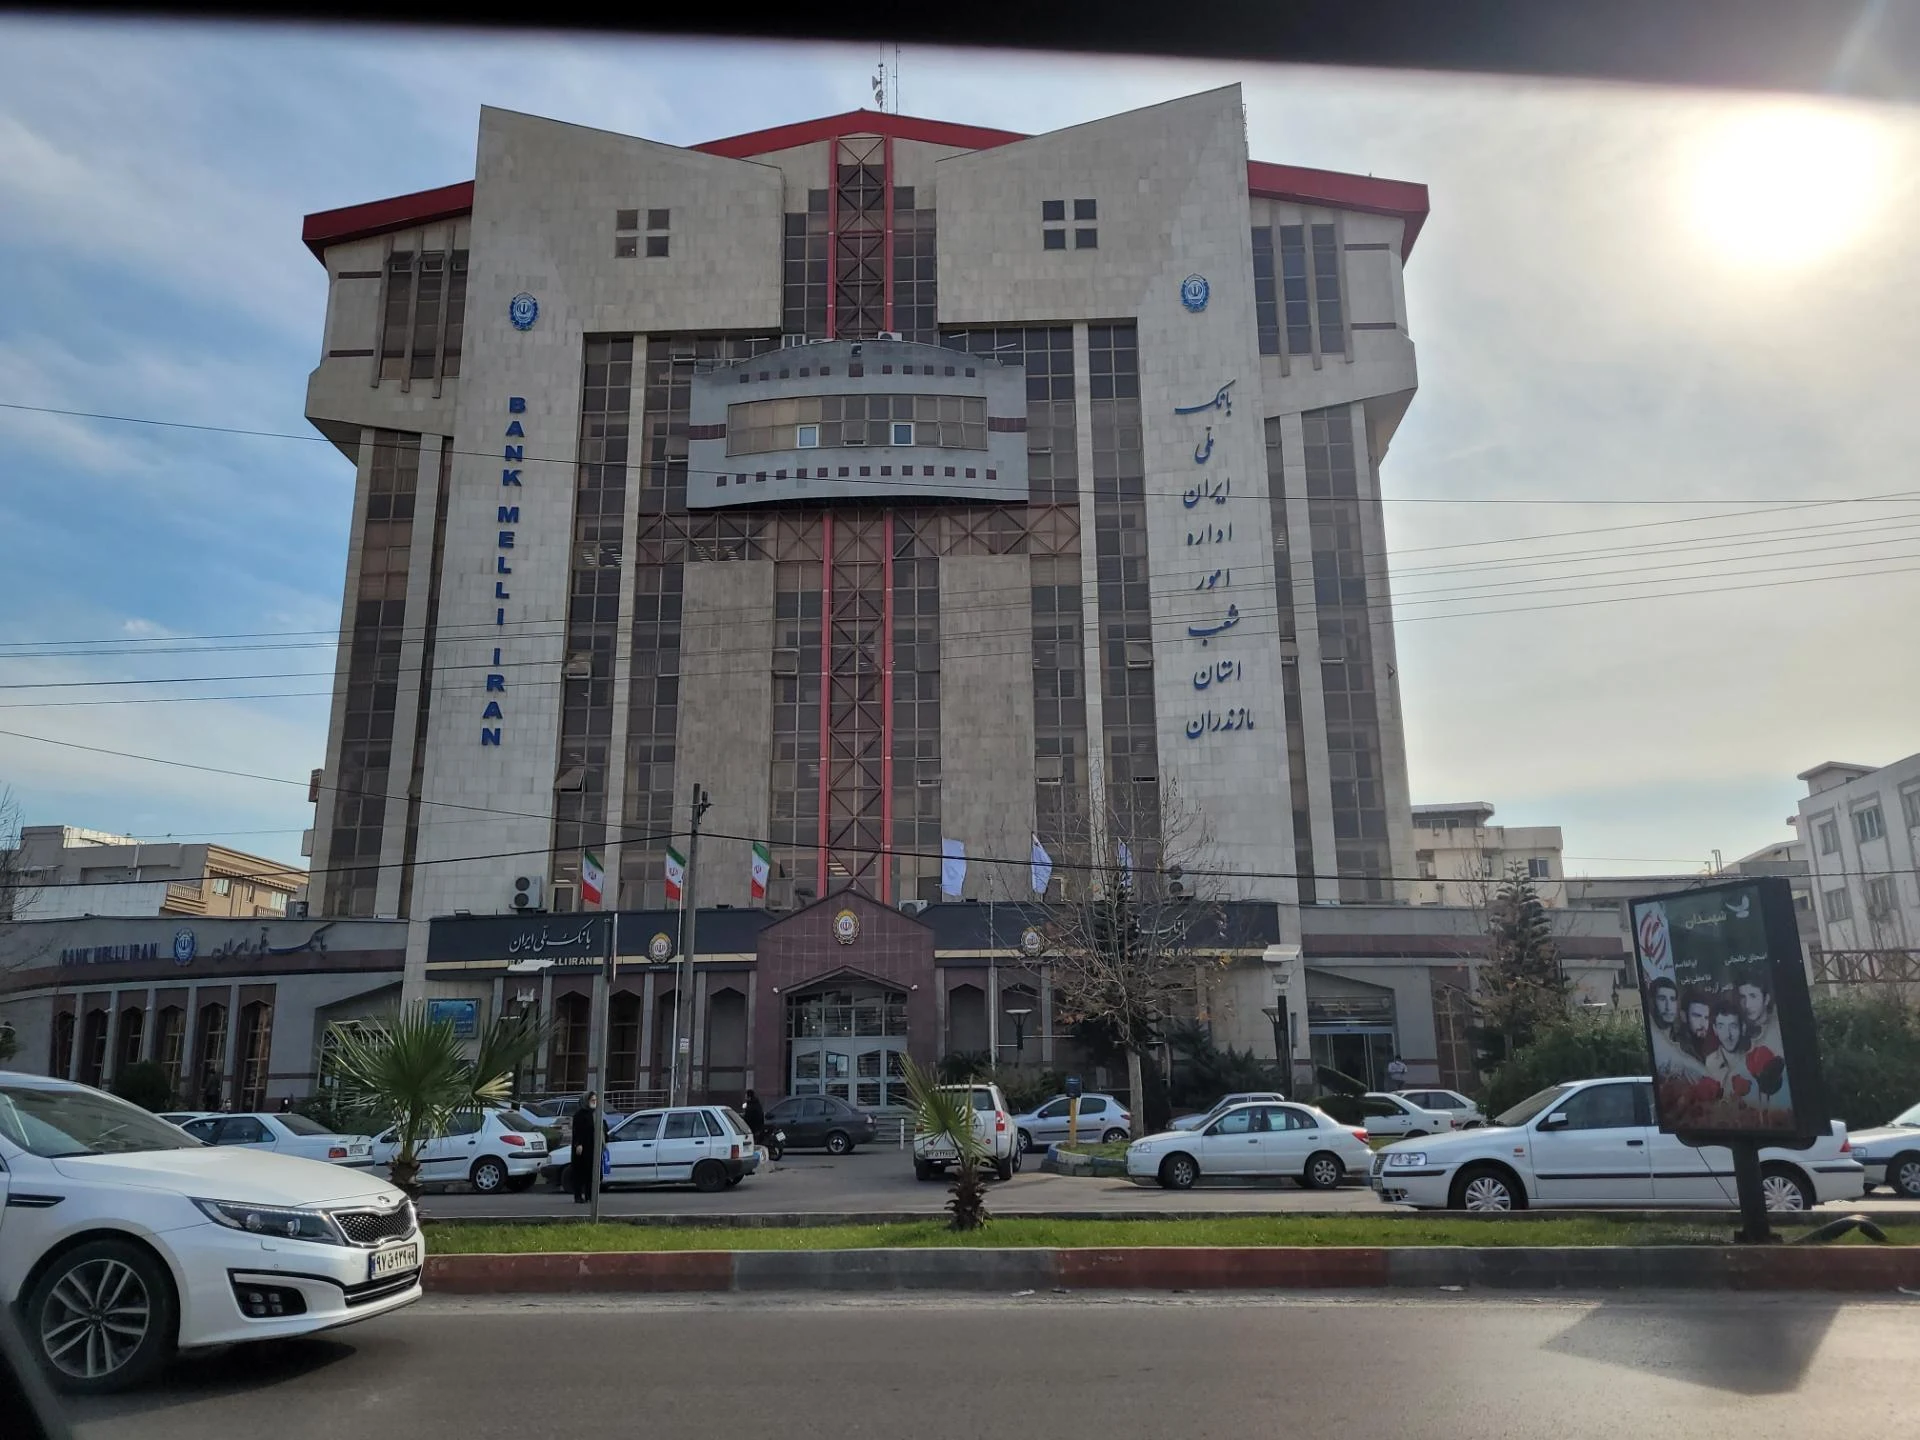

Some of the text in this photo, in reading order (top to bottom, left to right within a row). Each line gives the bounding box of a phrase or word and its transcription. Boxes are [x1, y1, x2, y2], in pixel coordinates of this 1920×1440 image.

[1174, 379, 1236, 417] بانک
[1194, 426, 1215, 465] ملی
[1183, 476, 1231, 509] ایران
[1187, 519, 1233, 547] اداره
[481, 397, 526, 746] BANK MELLI IRAN
[1196, 568, 1231, 591] امور
[1188, 603, 1242, 646] شعب
[1193, 659, 1242, 690] استان
[1186, 708, 1255, 739] مازندران
[509, 918, 595, 953] بانک ملی ایران
[568, 956, 592, 966] IRAN
